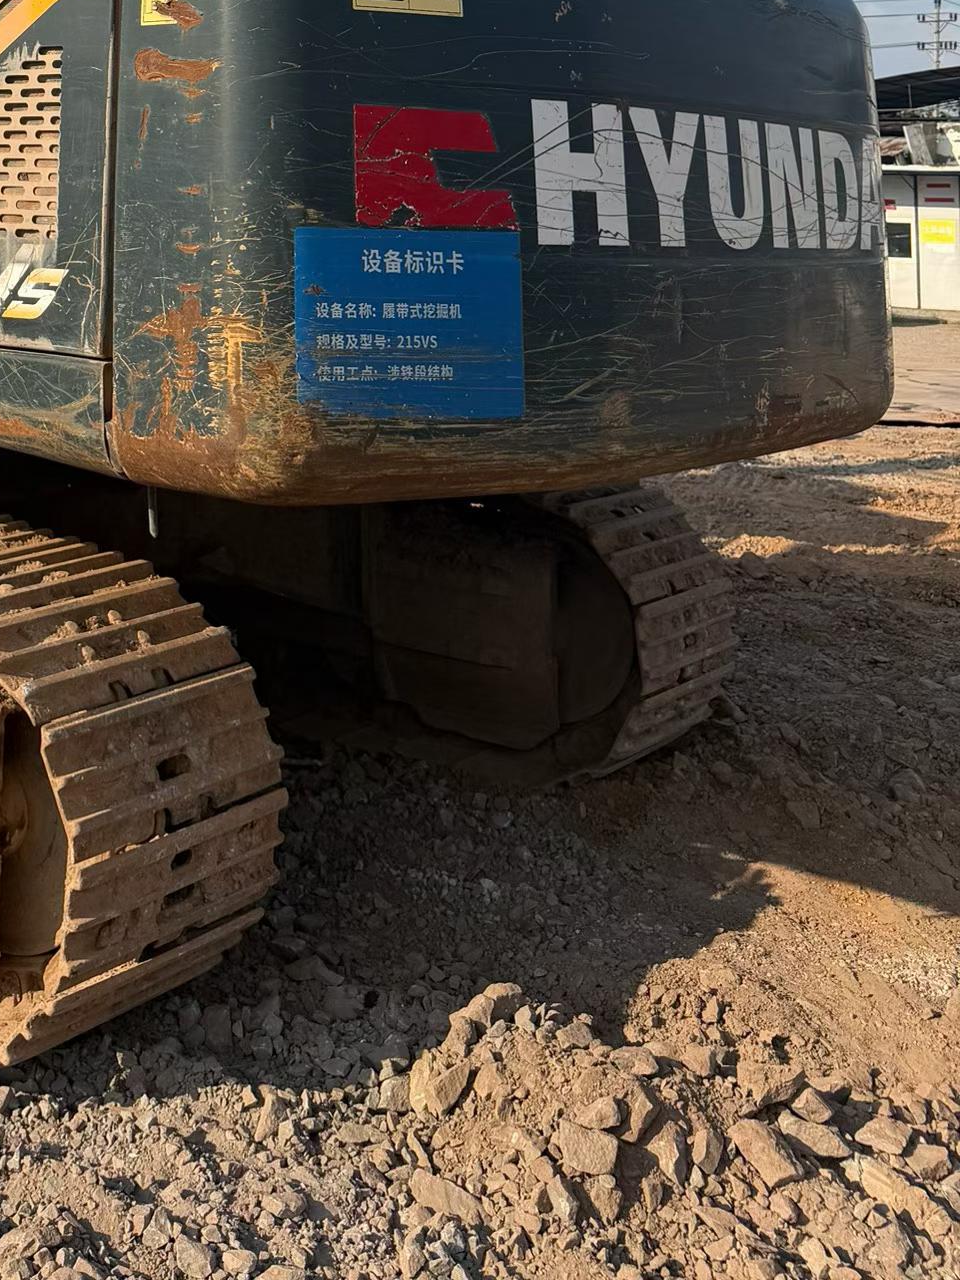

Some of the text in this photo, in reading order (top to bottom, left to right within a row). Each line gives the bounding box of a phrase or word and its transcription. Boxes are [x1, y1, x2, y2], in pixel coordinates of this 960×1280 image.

[530, 98, 883, 251] HYUNDA
[361, 248, 465, 275] 设备标识卡
